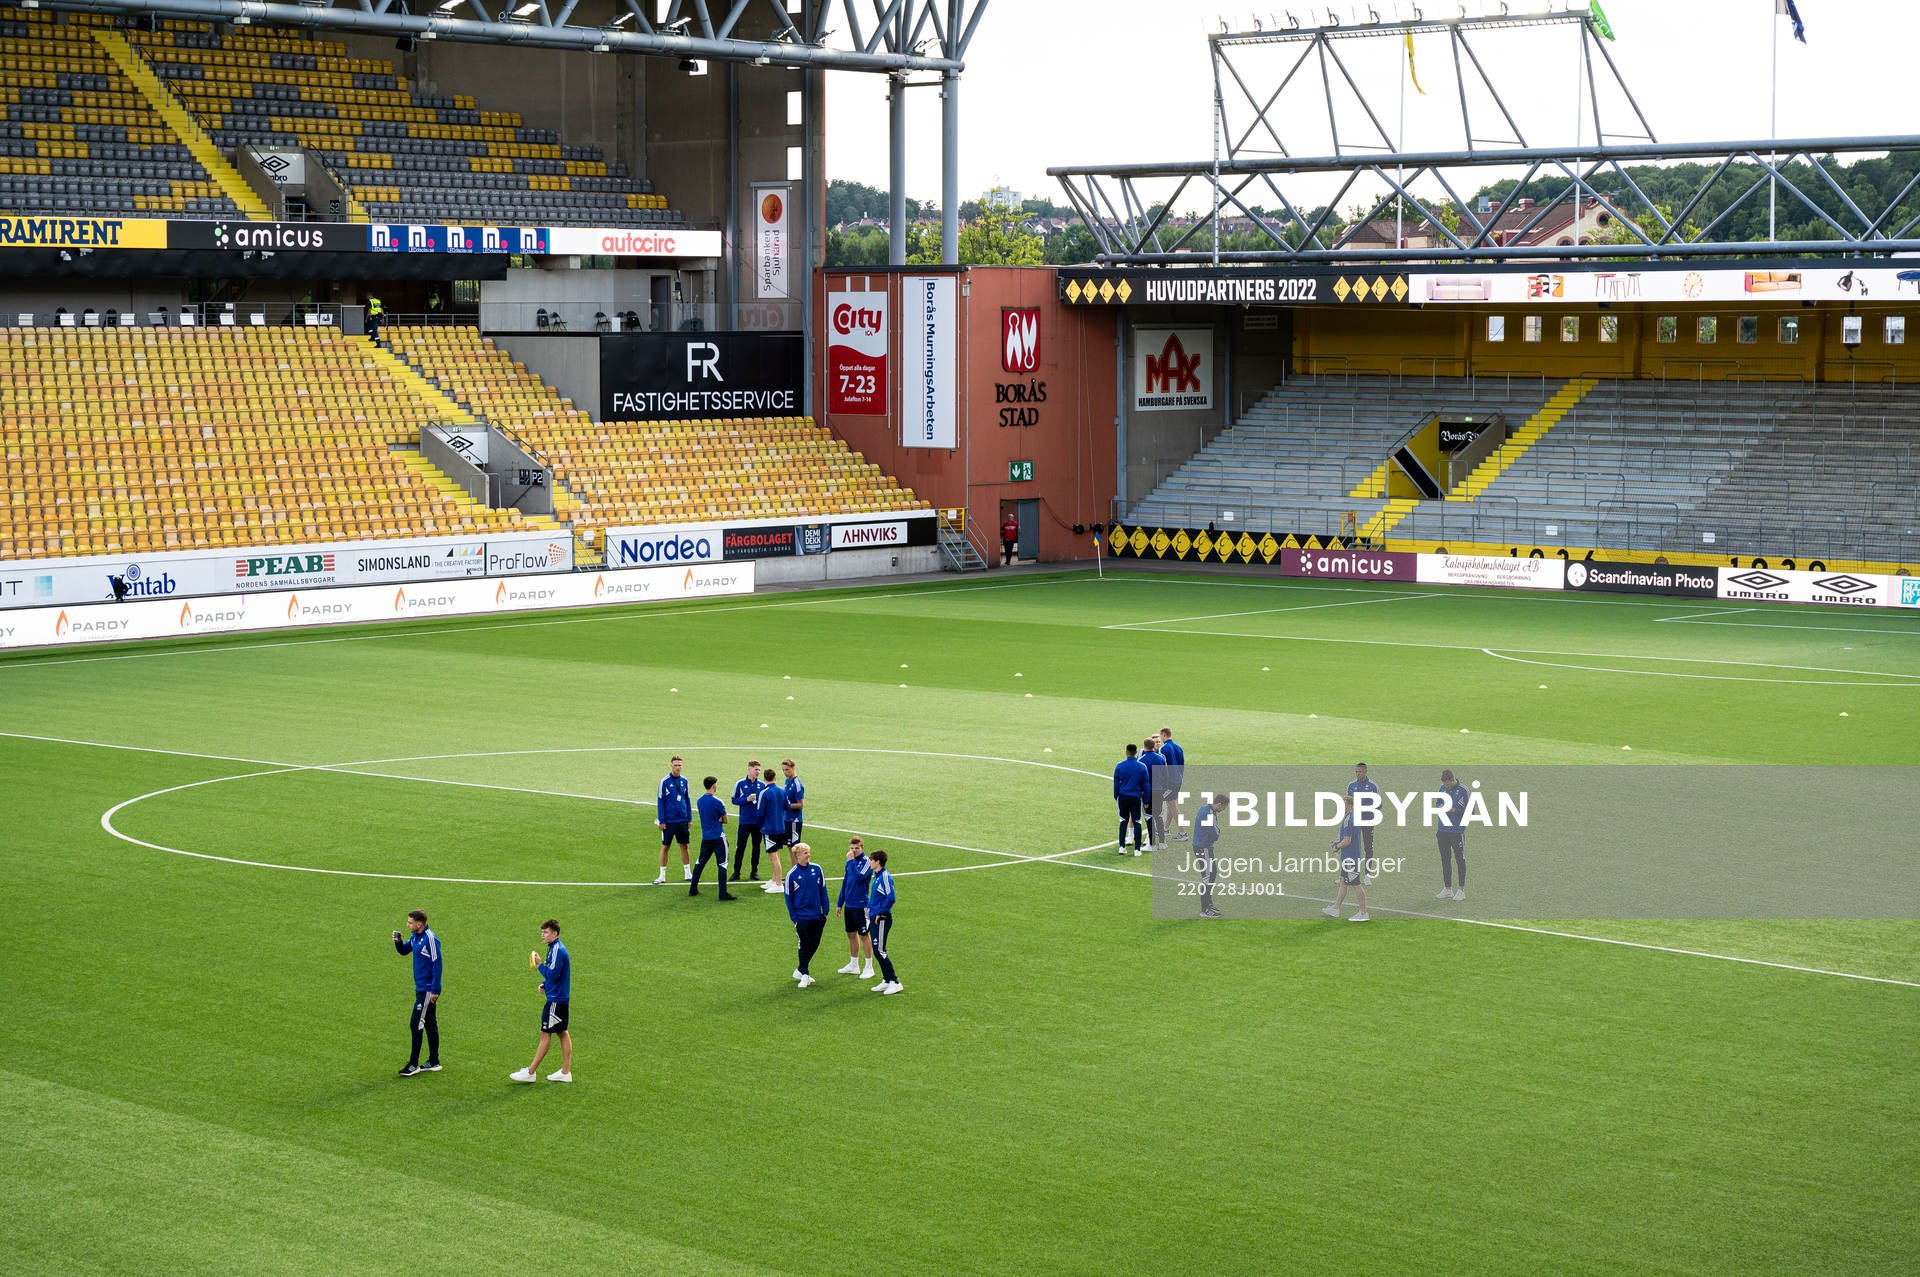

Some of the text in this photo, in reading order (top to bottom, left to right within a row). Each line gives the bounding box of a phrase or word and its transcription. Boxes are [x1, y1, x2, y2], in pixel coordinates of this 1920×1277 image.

[0, 219, 122, 244] RAMIRENT
[235, 224, 323, 248] amicus
[602, 233, 676, 254] autocirc
[764, 230, 772, 292] Sparbanken
[1146, 279, 1316, 301] HUVUDPARTNERS 2022
[833, 303, 882, 335] City
[687, 342, 724, 382] FR
[924, 281, 936, 440] Borås MurningsArbeten
[1146, 332, 1200, 394] MAX
[840, 375, 876, 394] 7-23
[996, 378, 1046, 403] BORÅS
[613, 390, 794, 412] FASTIGHETSSERVICE
[1139, 395, 1207, 407] HAMBURGARE PÅ SVENSKA
[999, 407, 1039, 427] STAD
[532, 471, 543, 484] P2
[725, 532, 792, 548] FÄRGBOLAGET
[842, 526, 897, 544] AHNVIKS
[620, 534, 711, 564] Nordea
[247, 555, 323, 576] PEAB
[358, 556, 431, 572] SIMONSLAND
[490, 552, 548, 571] ProFlow
[1317, 554, 1393, 575] amicus
[1590, 569, 1714, 590] Scandinavian Photo
